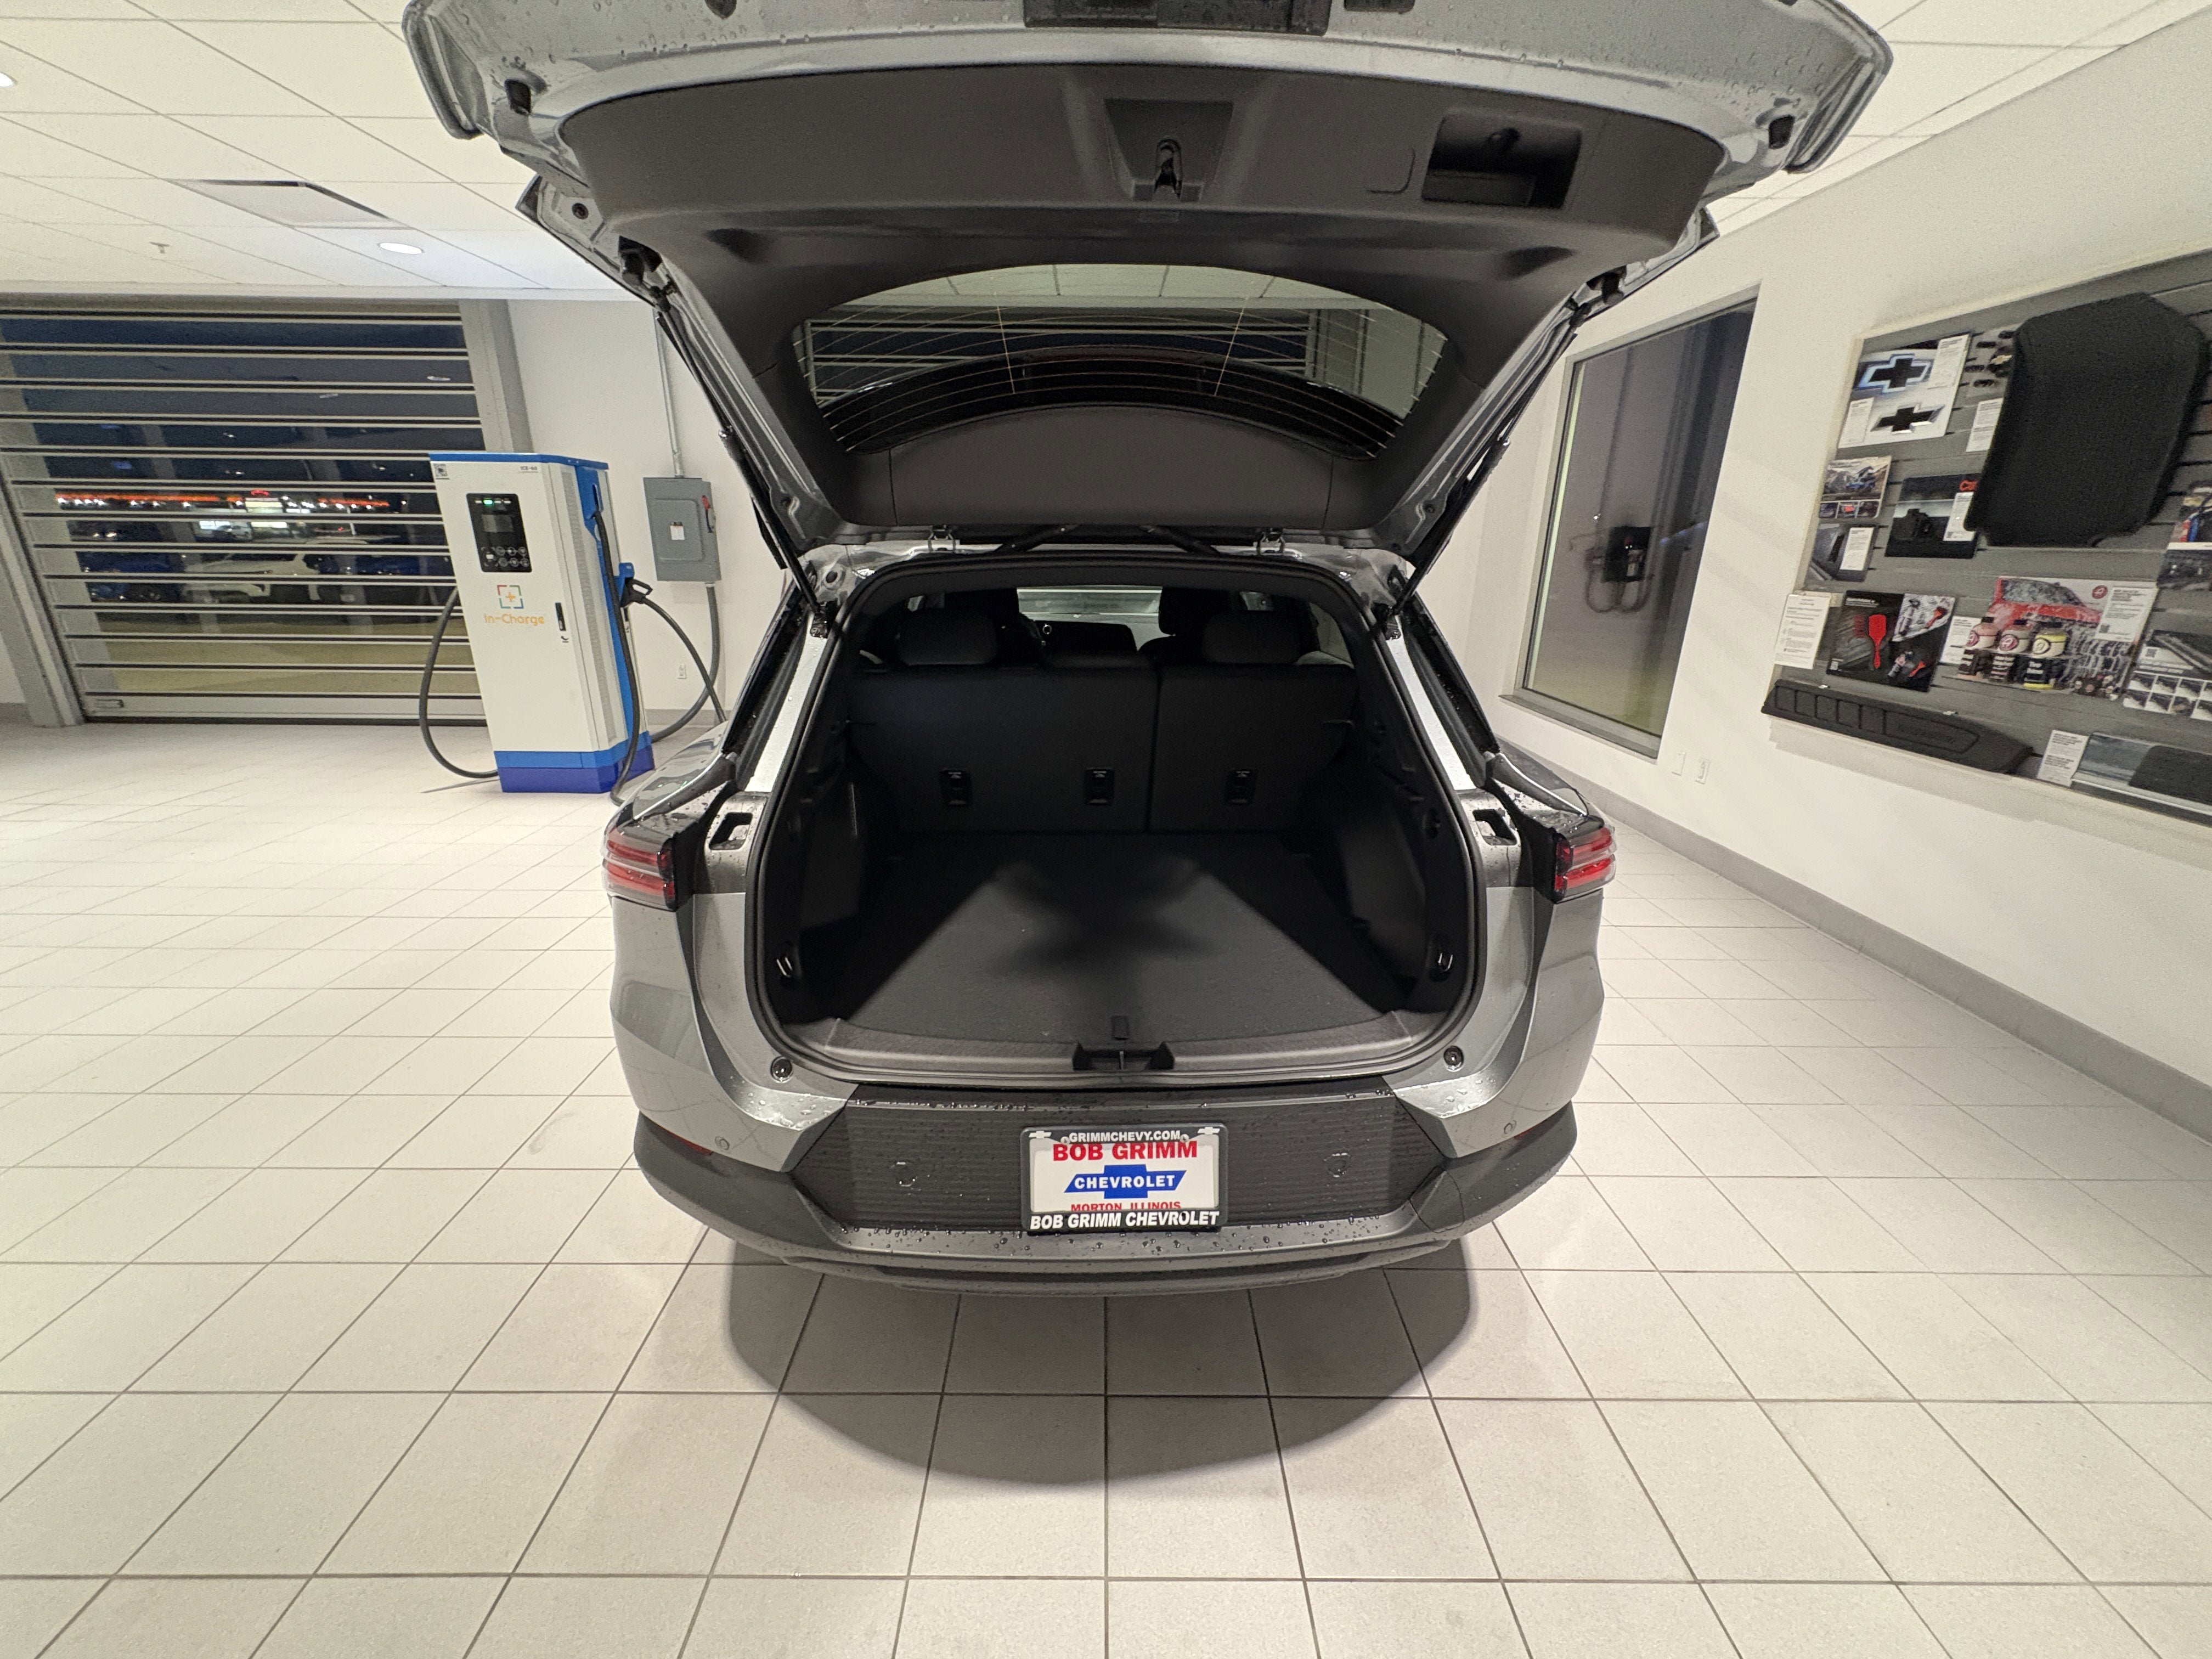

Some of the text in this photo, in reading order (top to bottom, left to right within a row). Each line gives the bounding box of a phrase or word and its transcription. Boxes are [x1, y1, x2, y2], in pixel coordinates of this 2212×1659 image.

[484, 613, 544, 626] In-Charge
[1069, 1130, 1181, 1142] GRIMMCHEVY.COM
[1053, 1141, 1197, 1161] BOB GRIMM
[1074, 1175, 1175, 1189] CHEVROLET
[1030, 1211, 1220, 1230] BOB GRIMM CHEVROLET
